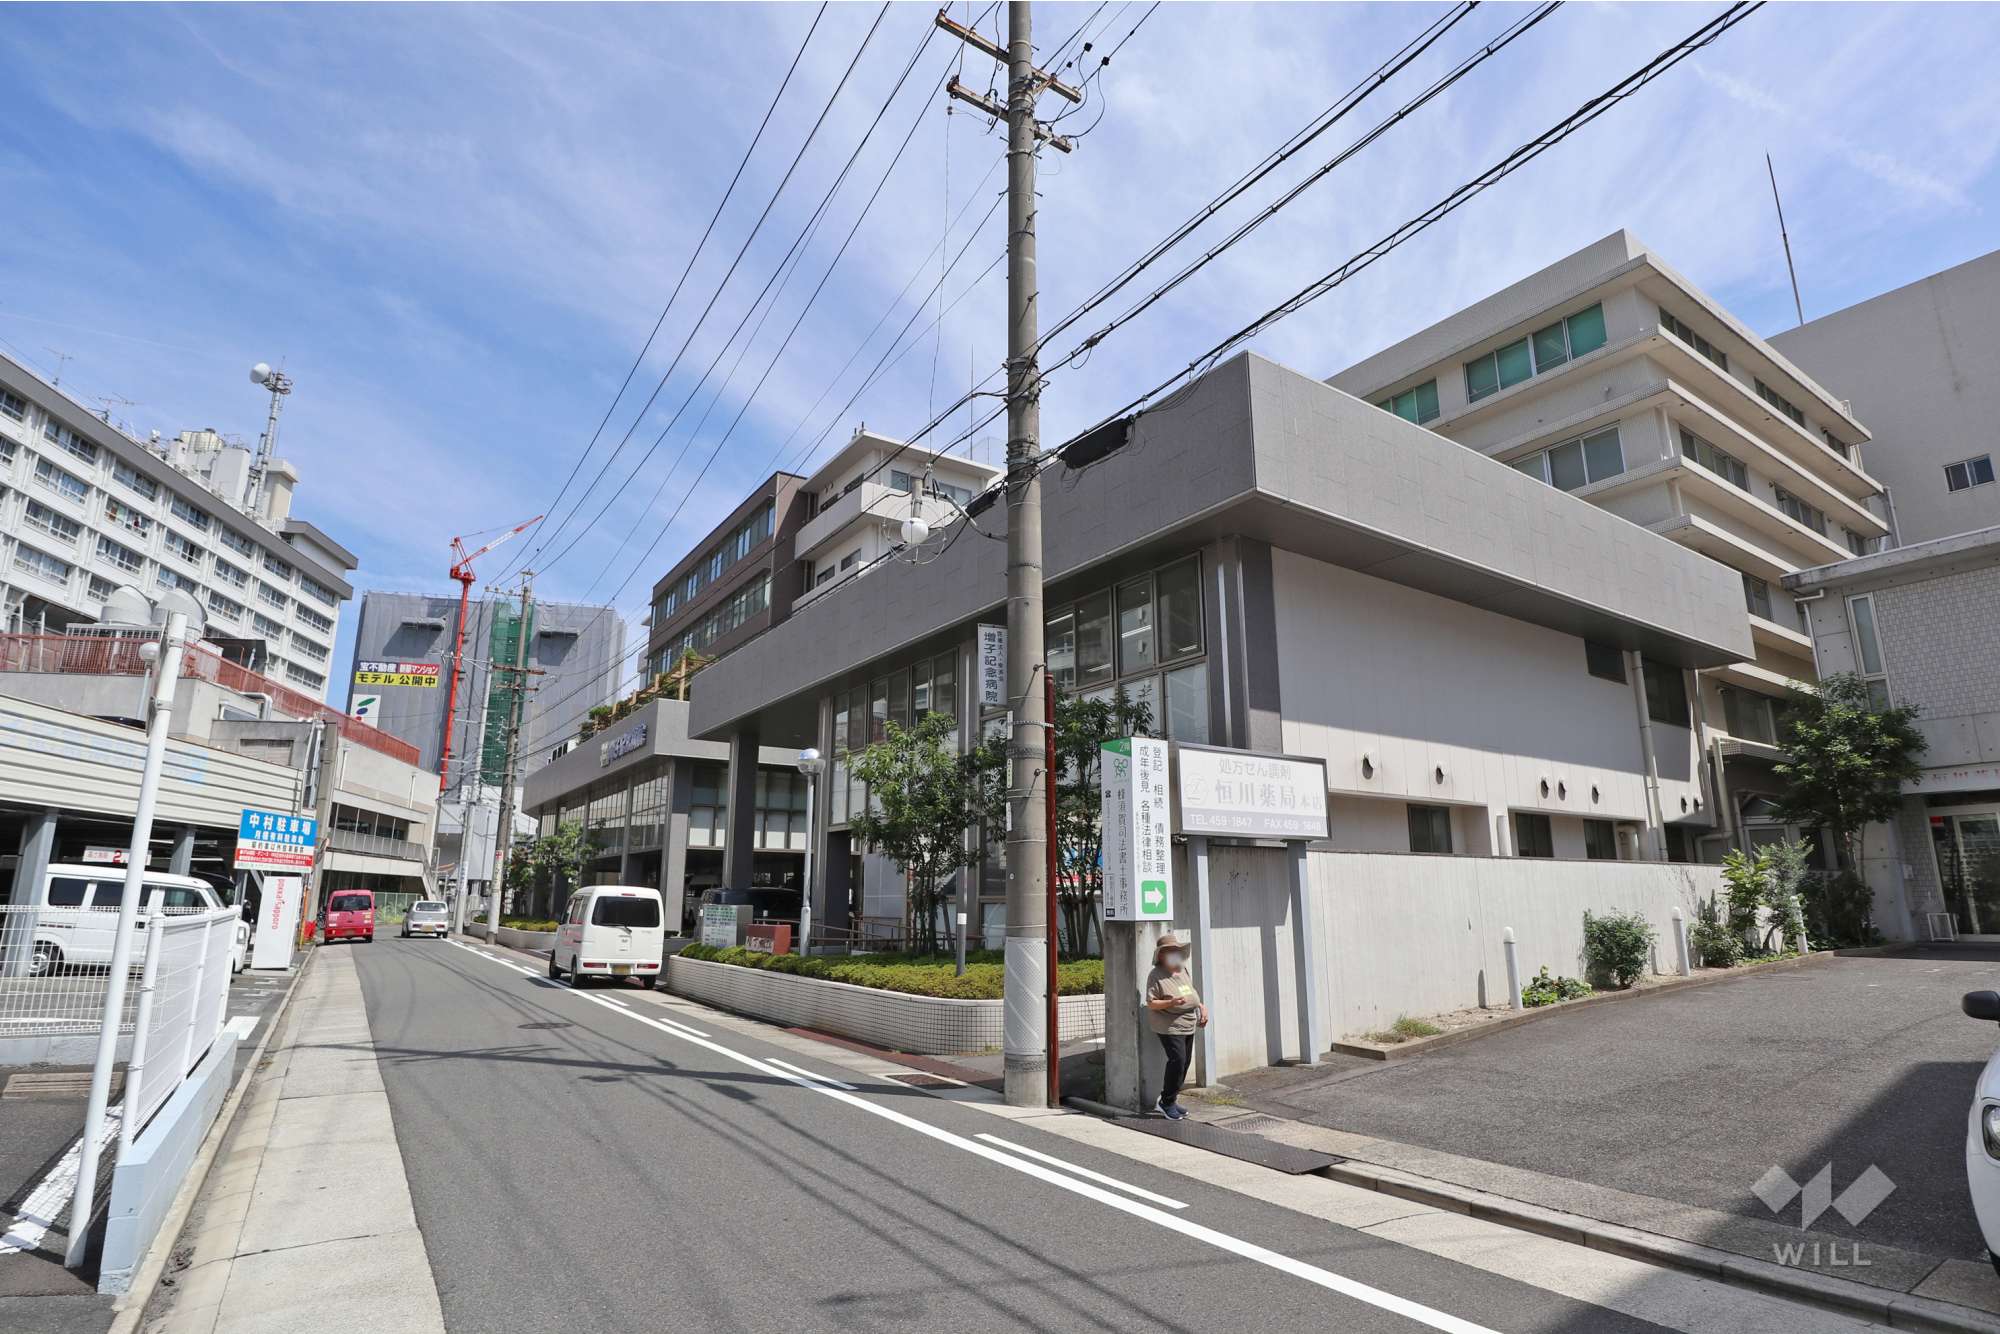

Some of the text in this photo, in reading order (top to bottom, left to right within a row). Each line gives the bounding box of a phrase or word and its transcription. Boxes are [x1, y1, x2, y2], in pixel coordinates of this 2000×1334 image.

[984, 631, 998, 702] 増子記念病院
[1216, 780, 1296, 809] 恒川薬局
[1219, 759, 1292, 780] 処方せん調剤
[249, 813, 312, 836] 中村駐車場
[1139, 746, 1153, 873] 成年後見 各種法律相談
[1153, 746, 1166, 874] 登記 相続 債務整理
